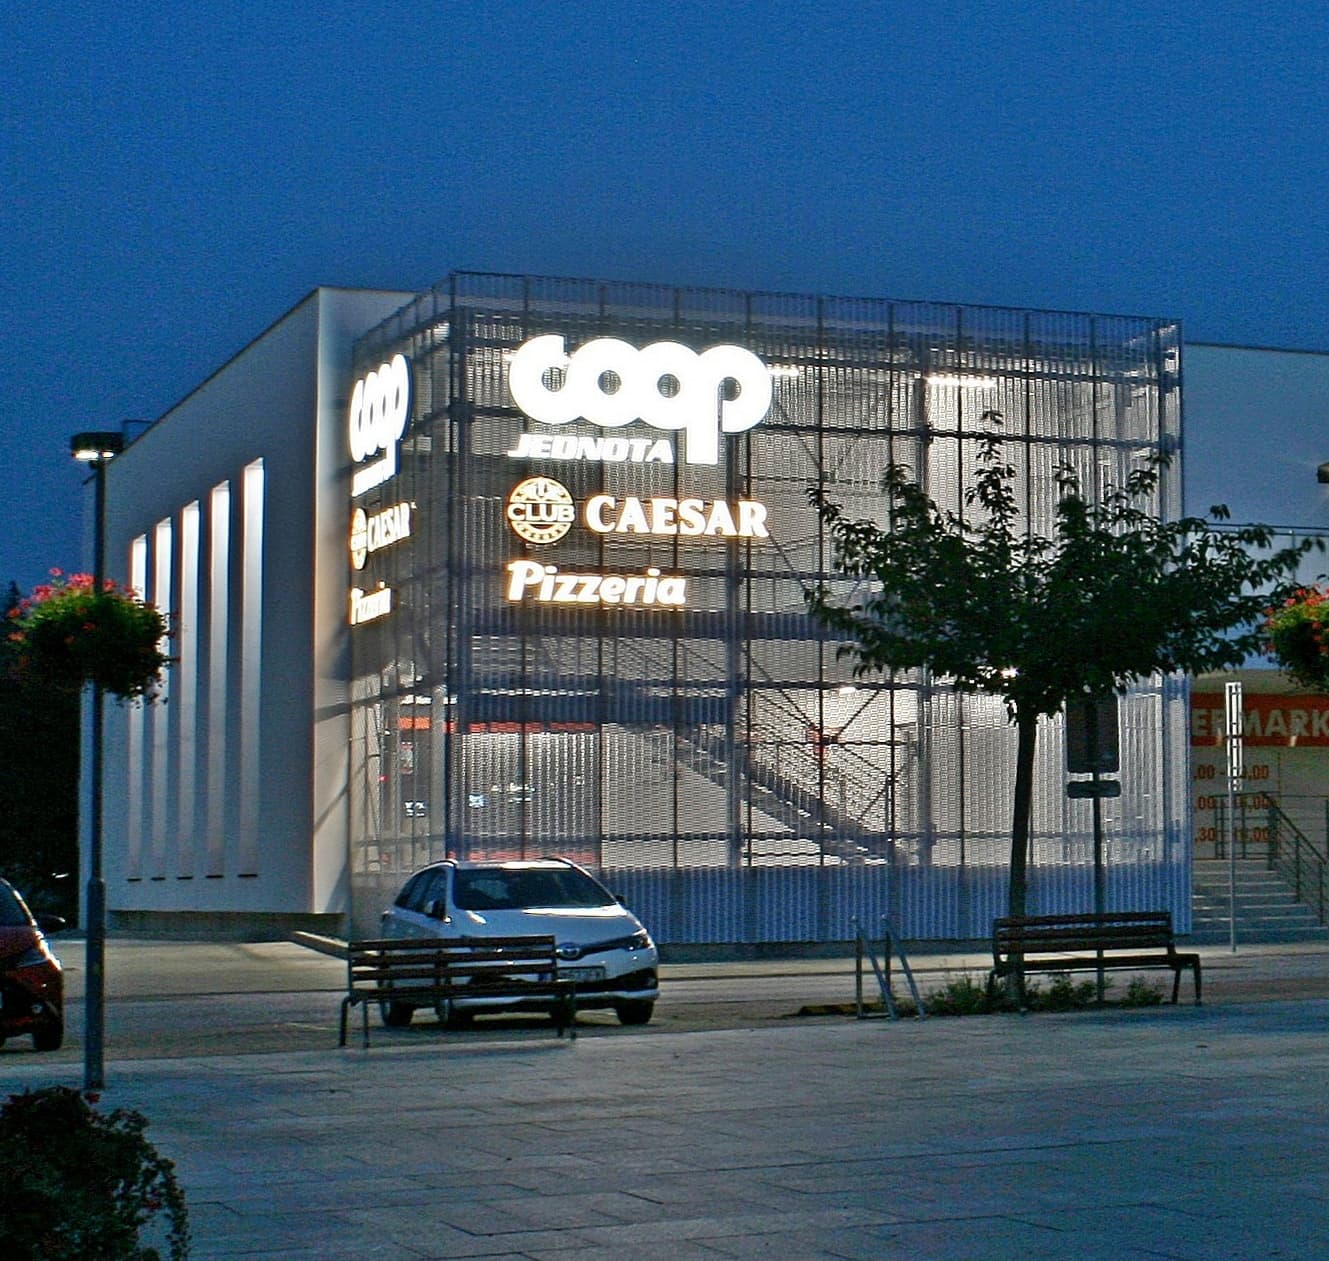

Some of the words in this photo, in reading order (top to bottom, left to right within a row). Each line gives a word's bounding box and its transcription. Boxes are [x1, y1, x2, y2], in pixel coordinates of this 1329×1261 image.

[508, 434, 674, 463] JEDNOTA
[508, 503, 575, 522] CLUB
[586, 496, 769, 537] CAESAR
[508, 560, 687, 604] Pizzeria
